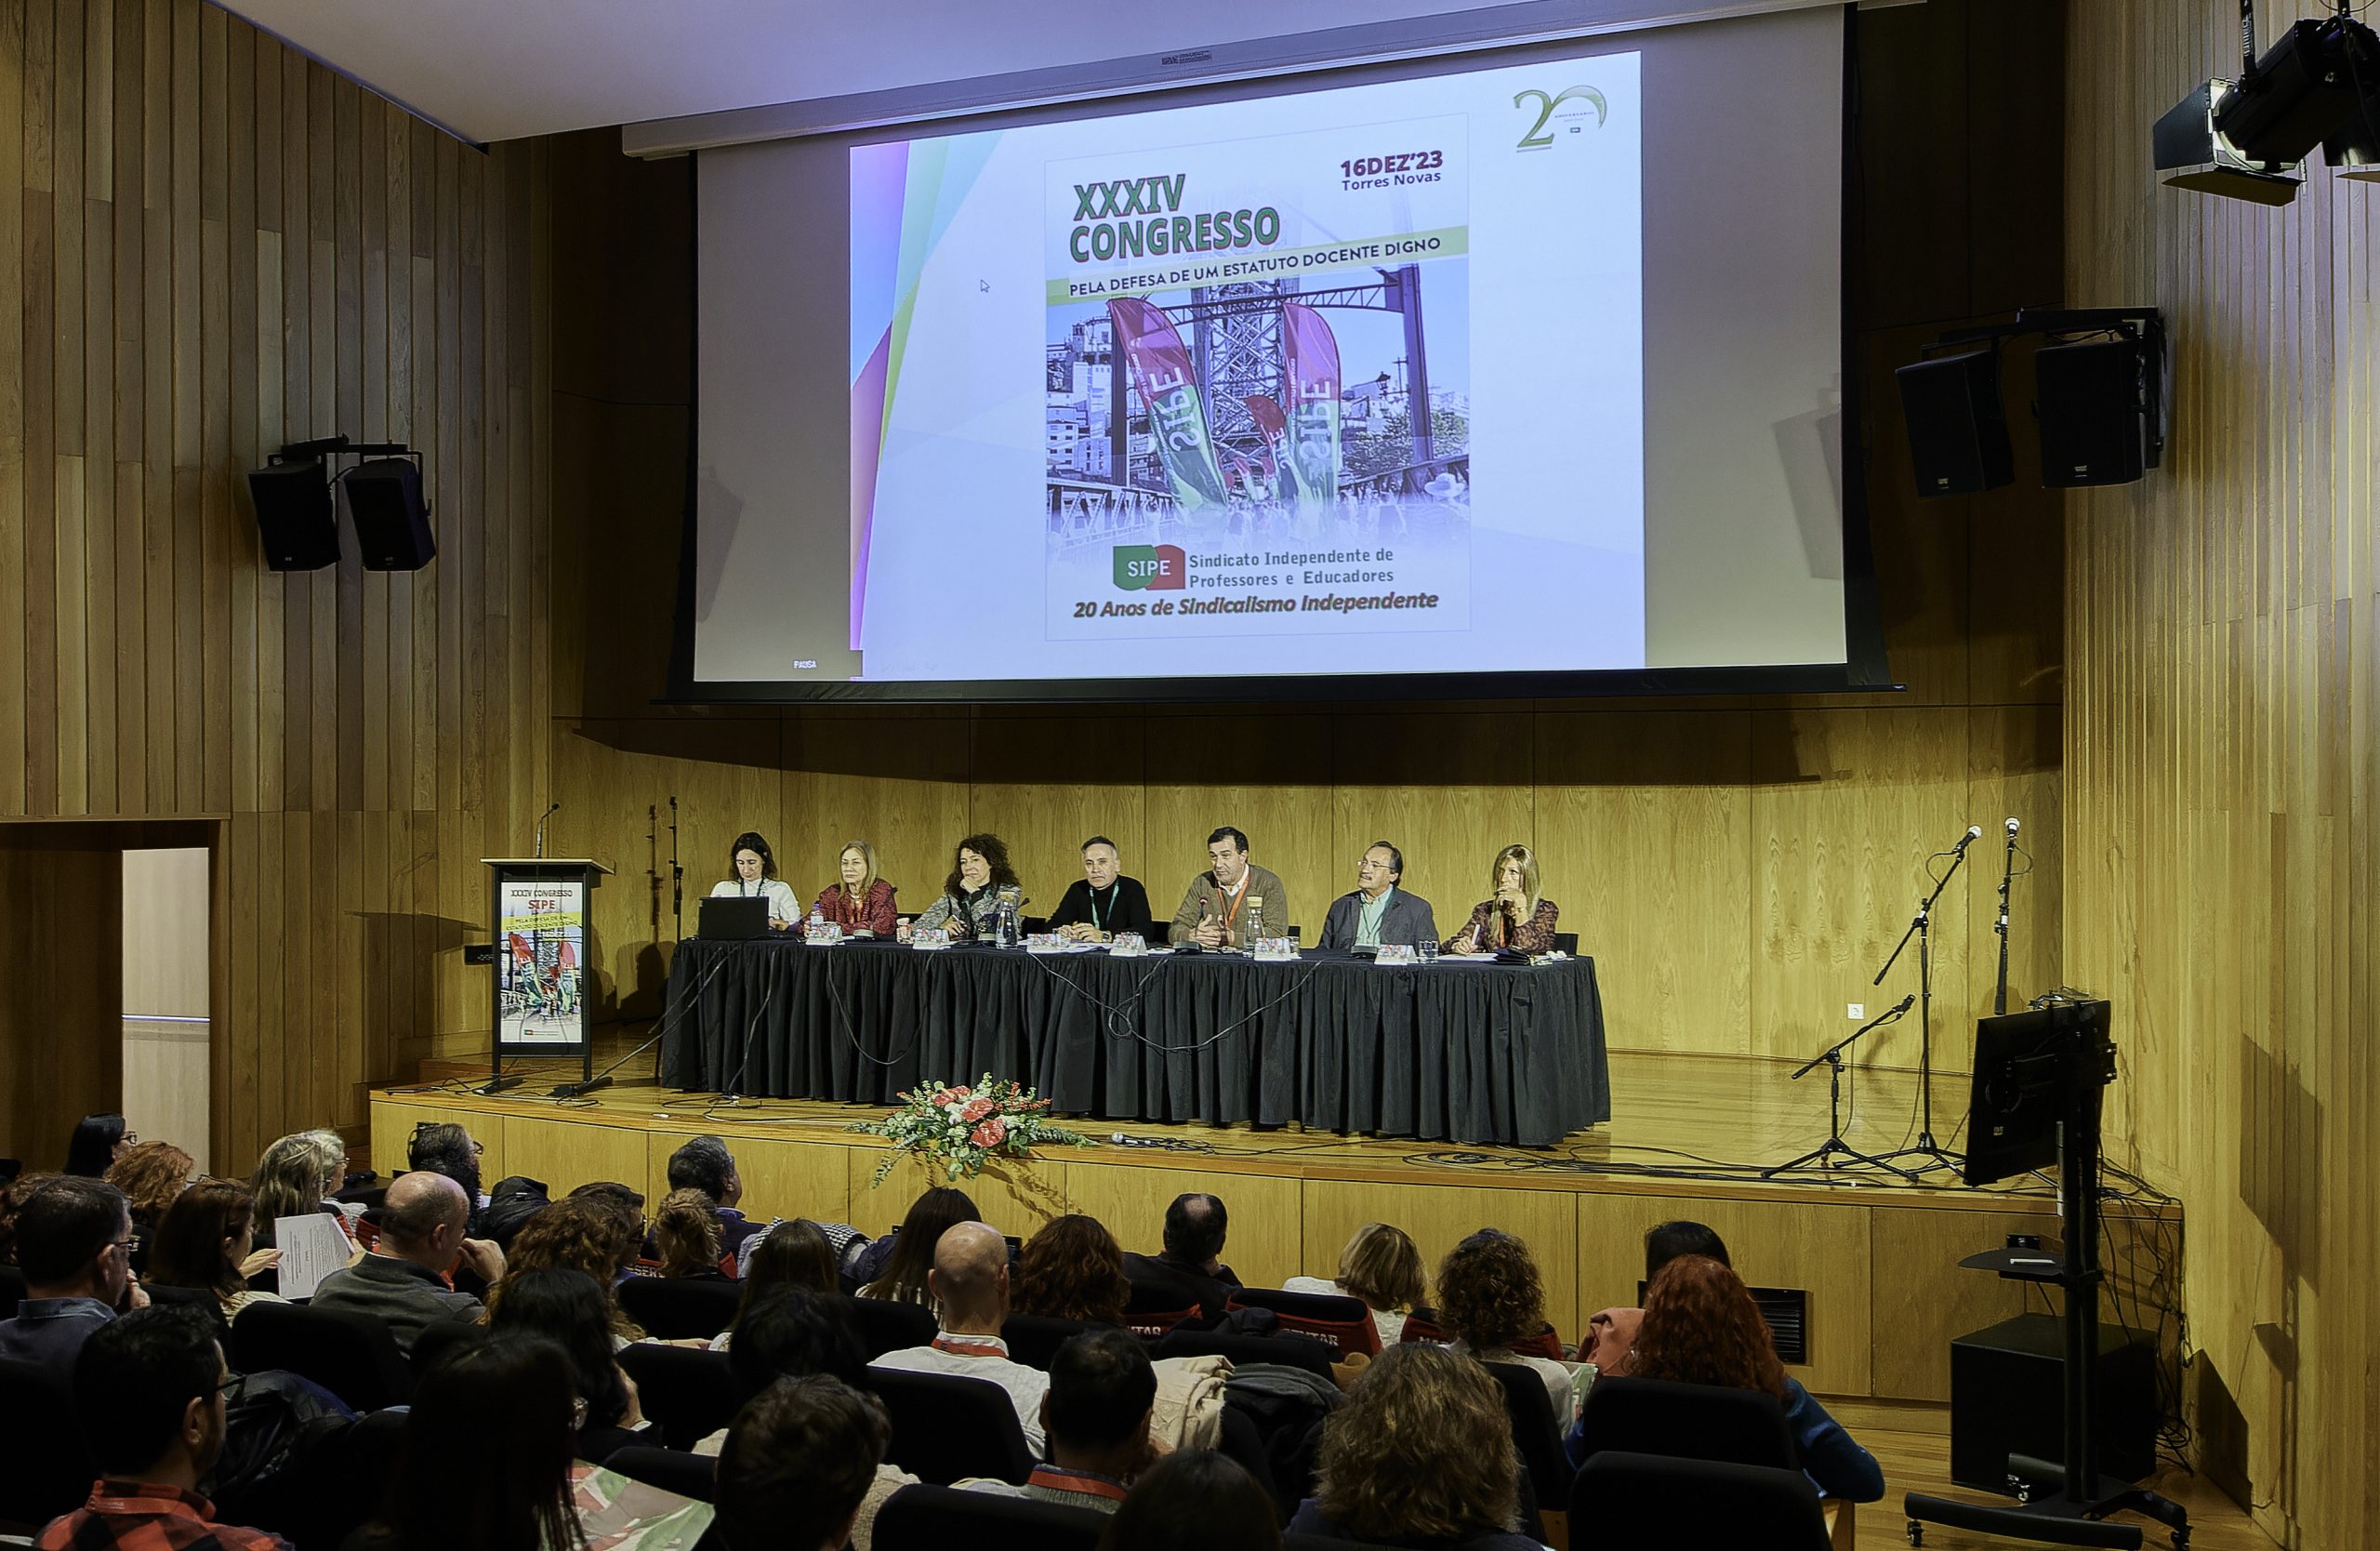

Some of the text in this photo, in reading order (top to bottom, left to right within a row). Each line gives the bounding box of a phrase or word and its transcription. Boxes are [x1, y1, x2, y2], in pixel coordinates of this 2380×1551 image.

[1342, 172, 1441, 191] Torres Novas
[1073, 174, 1186, 221] XXXIV
[1070, 206, 1280, 263] CONGRESSO
[1070, 237, 1441, 296] PELA DEFESA DE UM ESTATUTO DOCENTE DIGNO
[1189, 548, 1394, 568] Sindicato Independente de
[1128, 560, 1171, 577] SIPE
[1190, 569, 1395, 589] Professores e Educadores
[1073, 591, 1440, 618] 20 Anos de Sindicalismo Independente
[535, 889, 574, 897] CONGRESSO
[528, 899, 556, 909] SIPE
